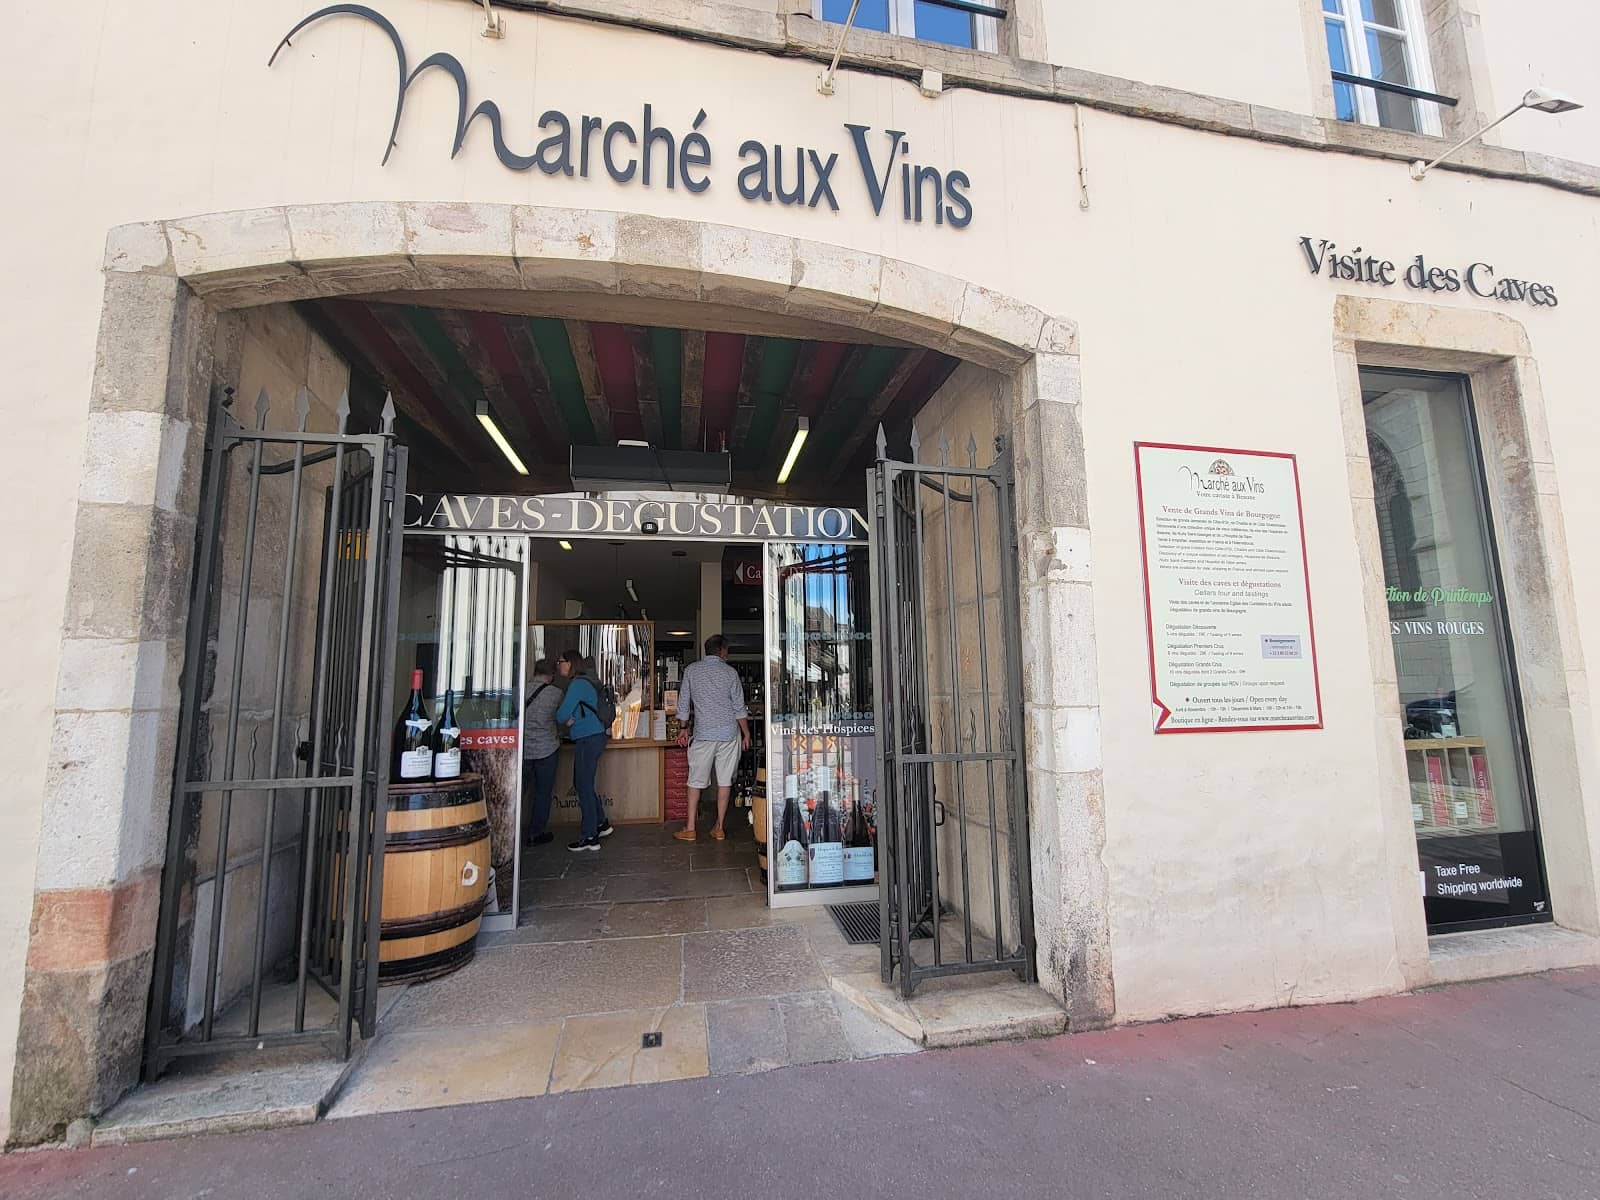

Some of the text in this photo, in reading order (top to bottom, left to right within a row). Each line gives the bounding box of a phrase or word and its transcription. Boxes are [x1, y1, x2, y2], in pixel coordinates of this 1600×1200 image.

[268, 3, 973, 228] Marché aux Vins
[1300, 236, 1558, 307] Visite des Caves
[1177, 465, 1265, 493] Marché aux Vins
[1162, 505, 1182, 514] Vente
[1194, 507, 1219, 516] Grands
[1220, 508, 1235, 516] Vins
[1236, 509, 1244, 517] de
[1245, 510, 1281, 520] Bourgogne
[746, 565, 762, 579] Ca
[1179, 577, 1199, 586] Visite
[1199, 578, 1212, 586] des
[1240, 580, 1282, 589] dégustations
[1384, 585, 1494, 608] tion de Printemps
[1405, 621, 1433, 635] VINS
[1436, 621, 1485, 635] ROUGES
[1232, 696, 1245, 704] jours
[1249, 695, 1264, 704] Open
[1170, 716, 1193, 725] Boutique
[771, 723, 875, 736] Vins des Hospices
[460, 735, 515, 745] es caves
[1434, 863, 1481, 877] Taxe Free
[1436, 876, 1523, 896] Shipping worldwide
